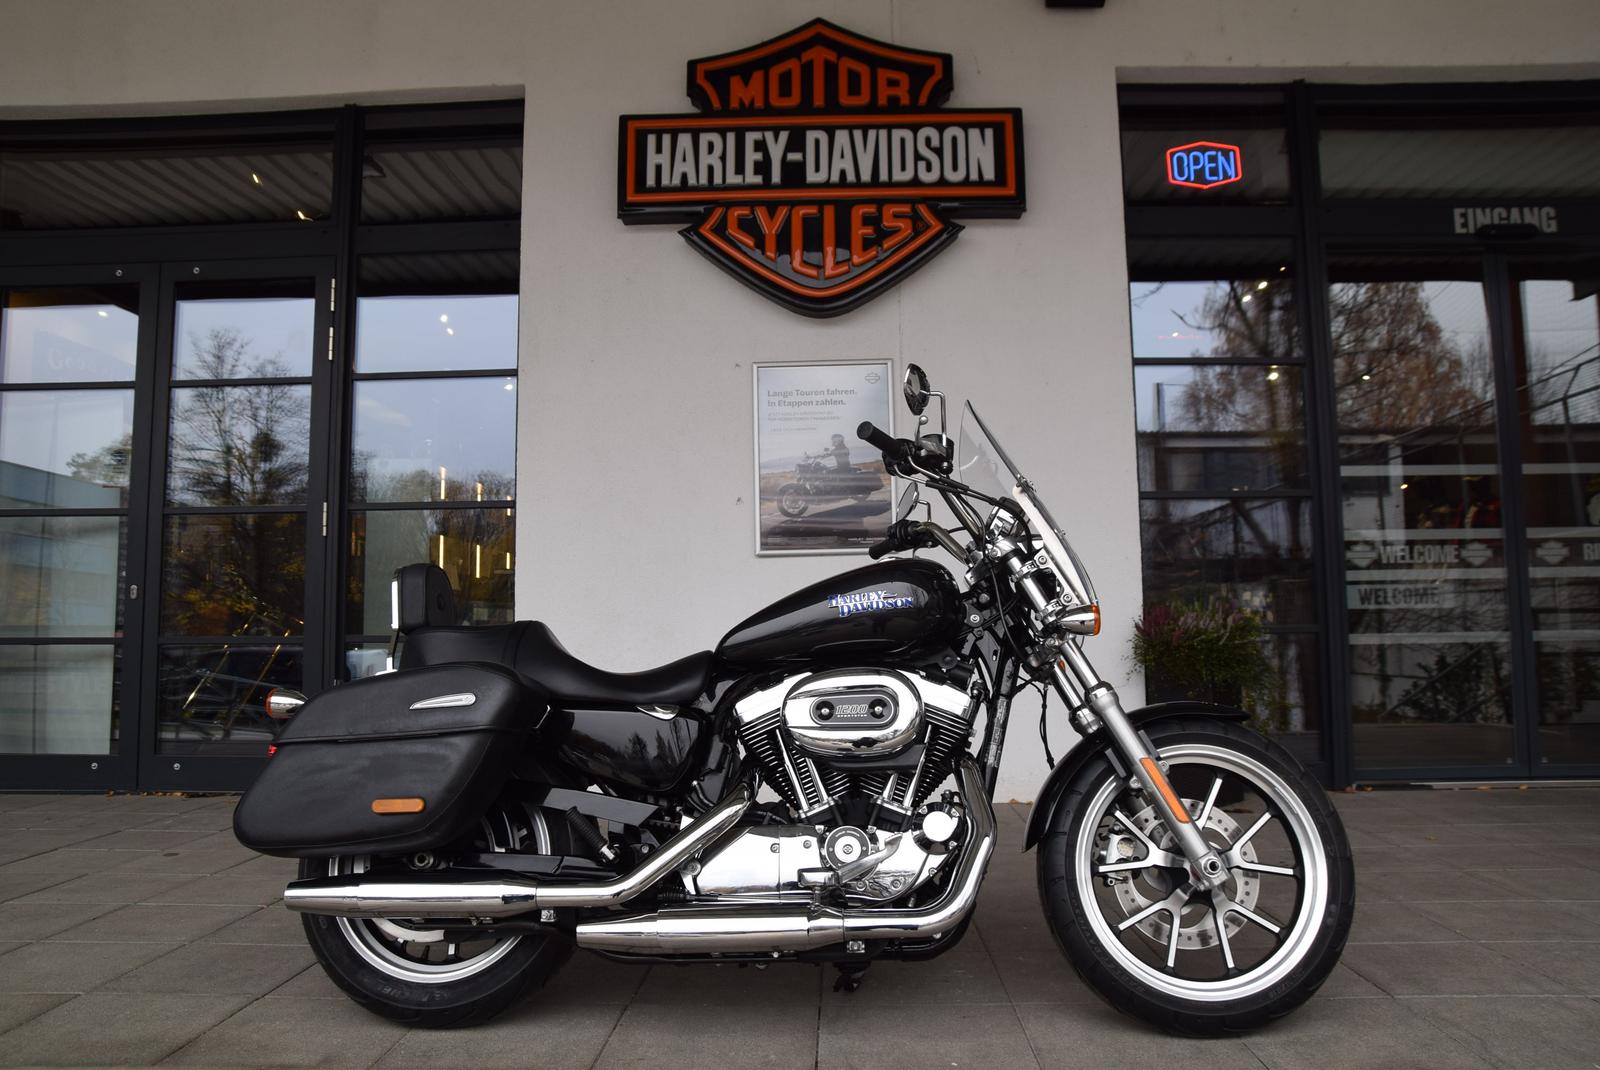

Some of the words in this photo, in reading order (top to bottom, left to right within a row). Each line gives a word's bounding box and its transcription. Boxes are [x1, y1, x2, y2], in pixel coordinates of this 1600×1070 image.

[729, 45, 911, 110] MOTOR
[646, 126, 995, 188] HARLEY-DAVIDSON
[1172, 150, 1236, 182] OPEN
[725, 203, 913, 280] CYCLES
[767, 389, 793, 398] Lange
[795, 388, 825, 397] Touren
[777, 399, 813, 408] Etappen
[1379, 544, 1459, 564] WELCOME
[1583, 543, 1600, 561] RI
[1358, 586, 1440, 605] WELCOME
[839, 597, 914, 617] DAVIDSON
[835, 703, 868, 715] 1200
